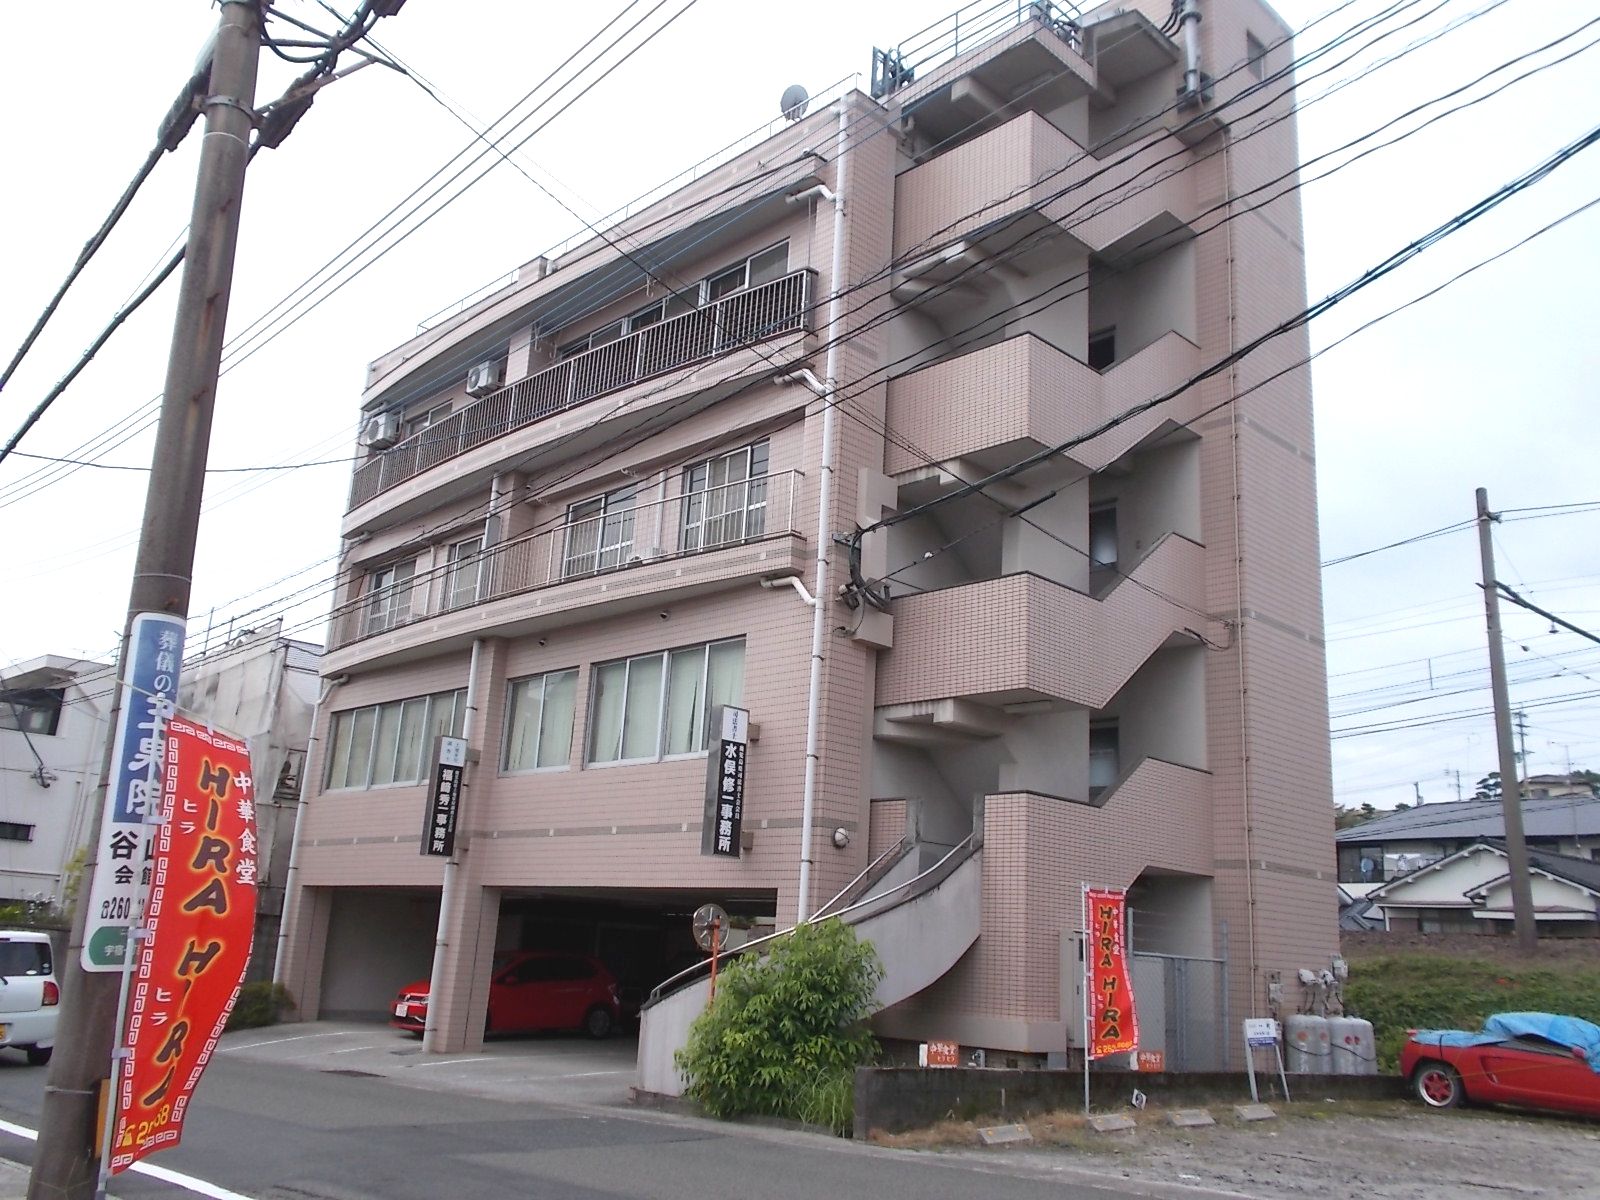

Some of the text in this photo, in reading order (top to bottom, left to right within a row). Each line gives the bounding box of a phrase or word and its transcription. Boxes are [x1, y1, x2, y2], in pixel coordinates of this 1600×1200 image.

[178, 798, 199, 835] ヒラ
[233, 770, 258, 886] 中華食堂
[718, 743, 738, 853] 水俣修一事務所
[182, 758, 231, 915] HIRA
[1099, 906, 1114, 968] HIRA
[151, 987, 172, 1026] ヒラ
[1101, 977, 1121, 1040] HIRA
